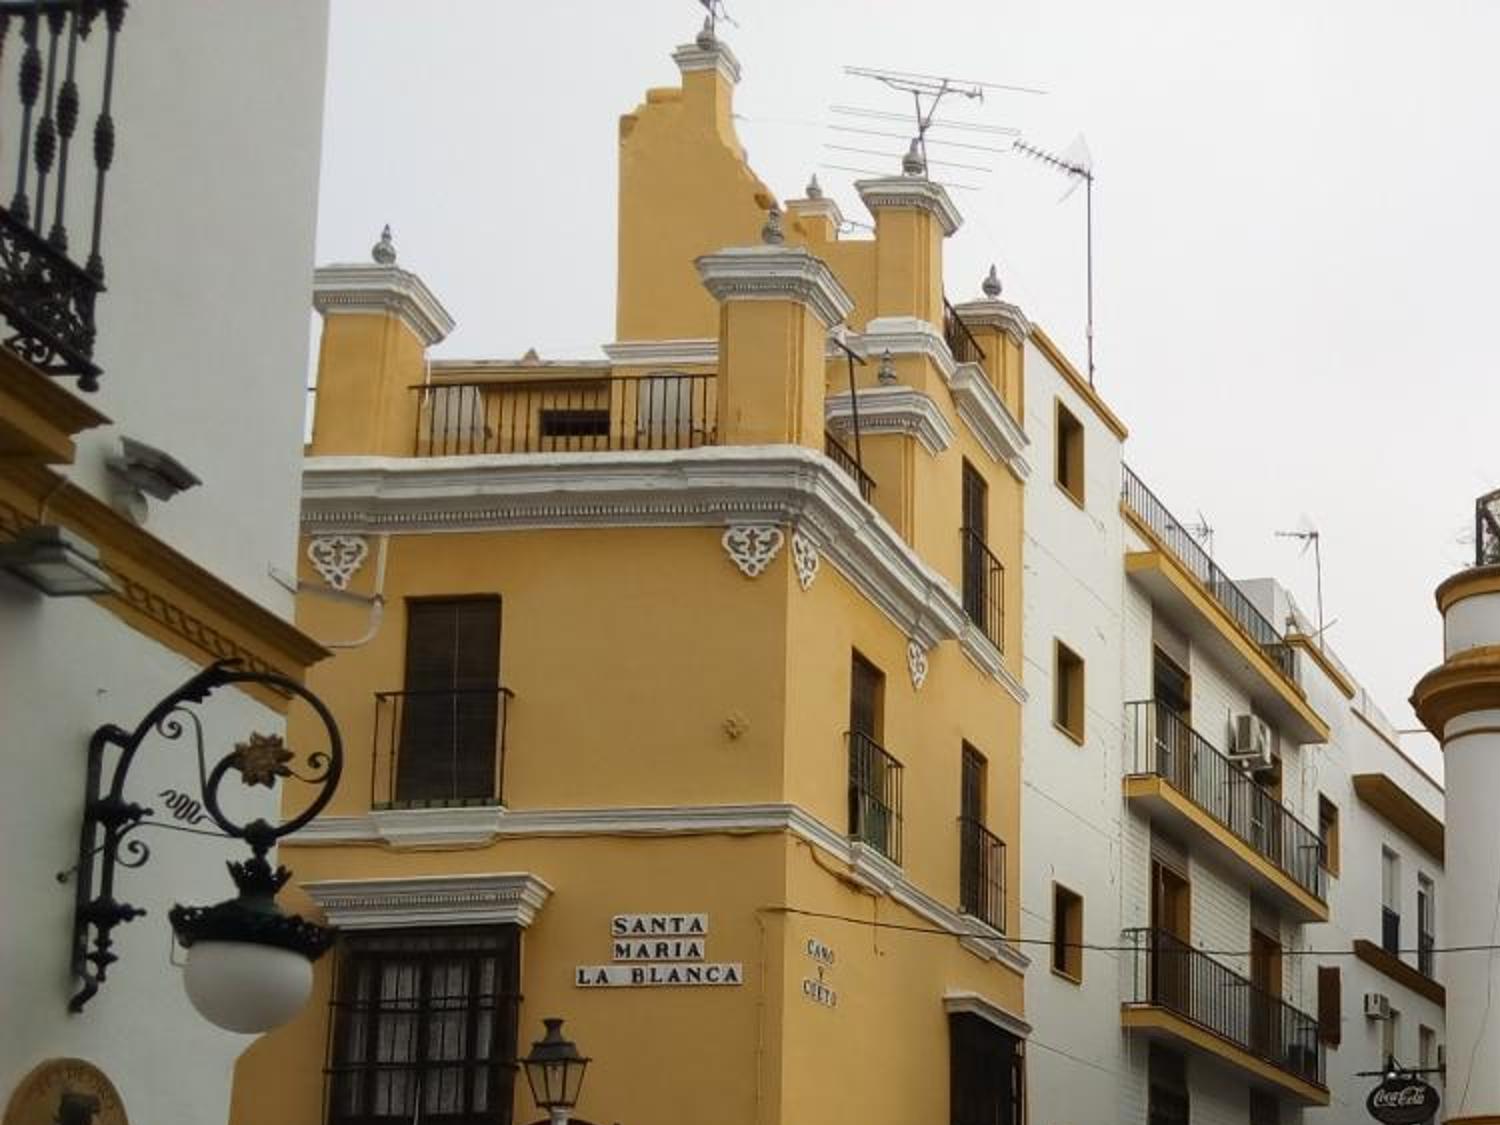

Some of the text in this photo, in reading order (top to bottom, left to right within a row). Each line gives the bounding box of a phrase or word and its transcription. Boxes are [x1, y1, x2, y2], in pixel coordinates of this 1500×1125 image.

[613, 917, 705, 935] SANTA
[614, 942, 702, 959] MARIA
[577, 966, 739, 985] LA BLANCA
